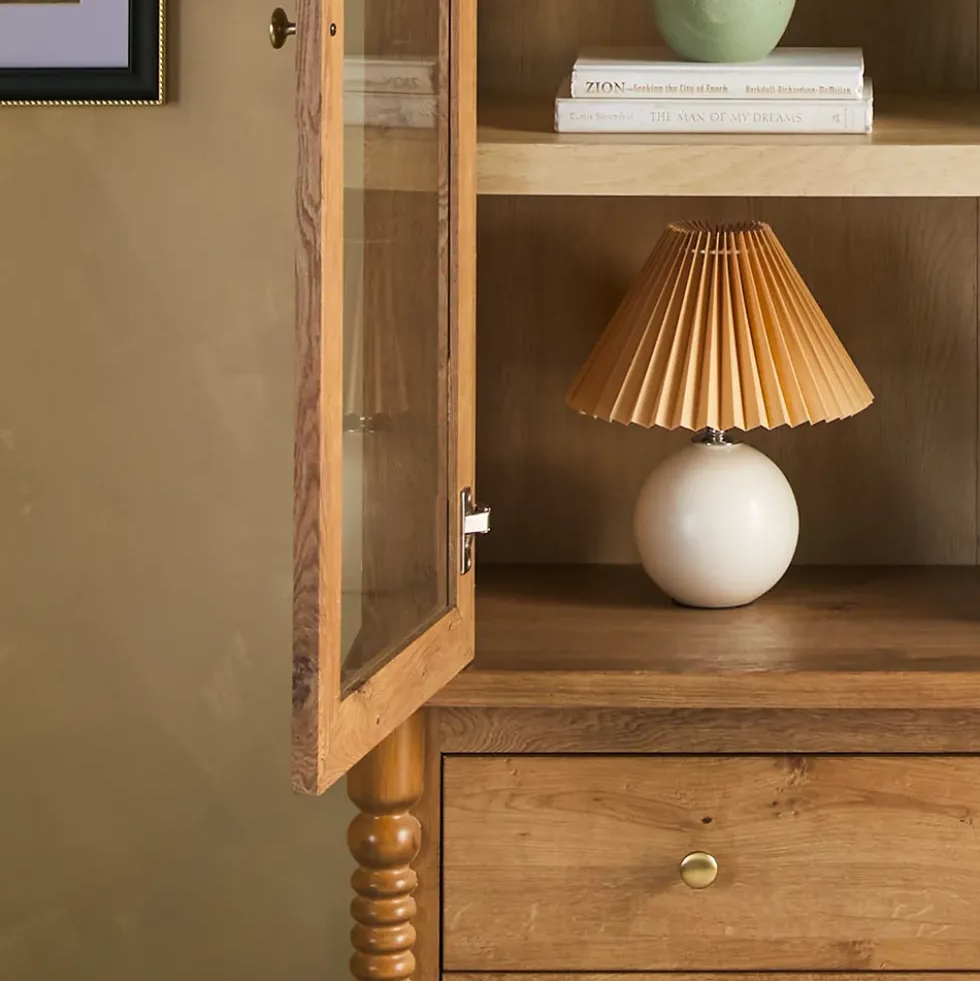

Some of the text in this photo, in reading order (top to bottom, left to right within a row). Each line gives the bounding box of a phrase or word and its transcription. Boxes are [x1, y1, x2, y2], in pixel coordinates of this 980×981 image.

[665, 84, 677, 93] the
[680, 84, 694, 95] City
[696, 84, 703, 93] of
[706, 84, 728, 93] Enoch
[650, 111, 803, 122] THE MAN OF MY DREAMS
